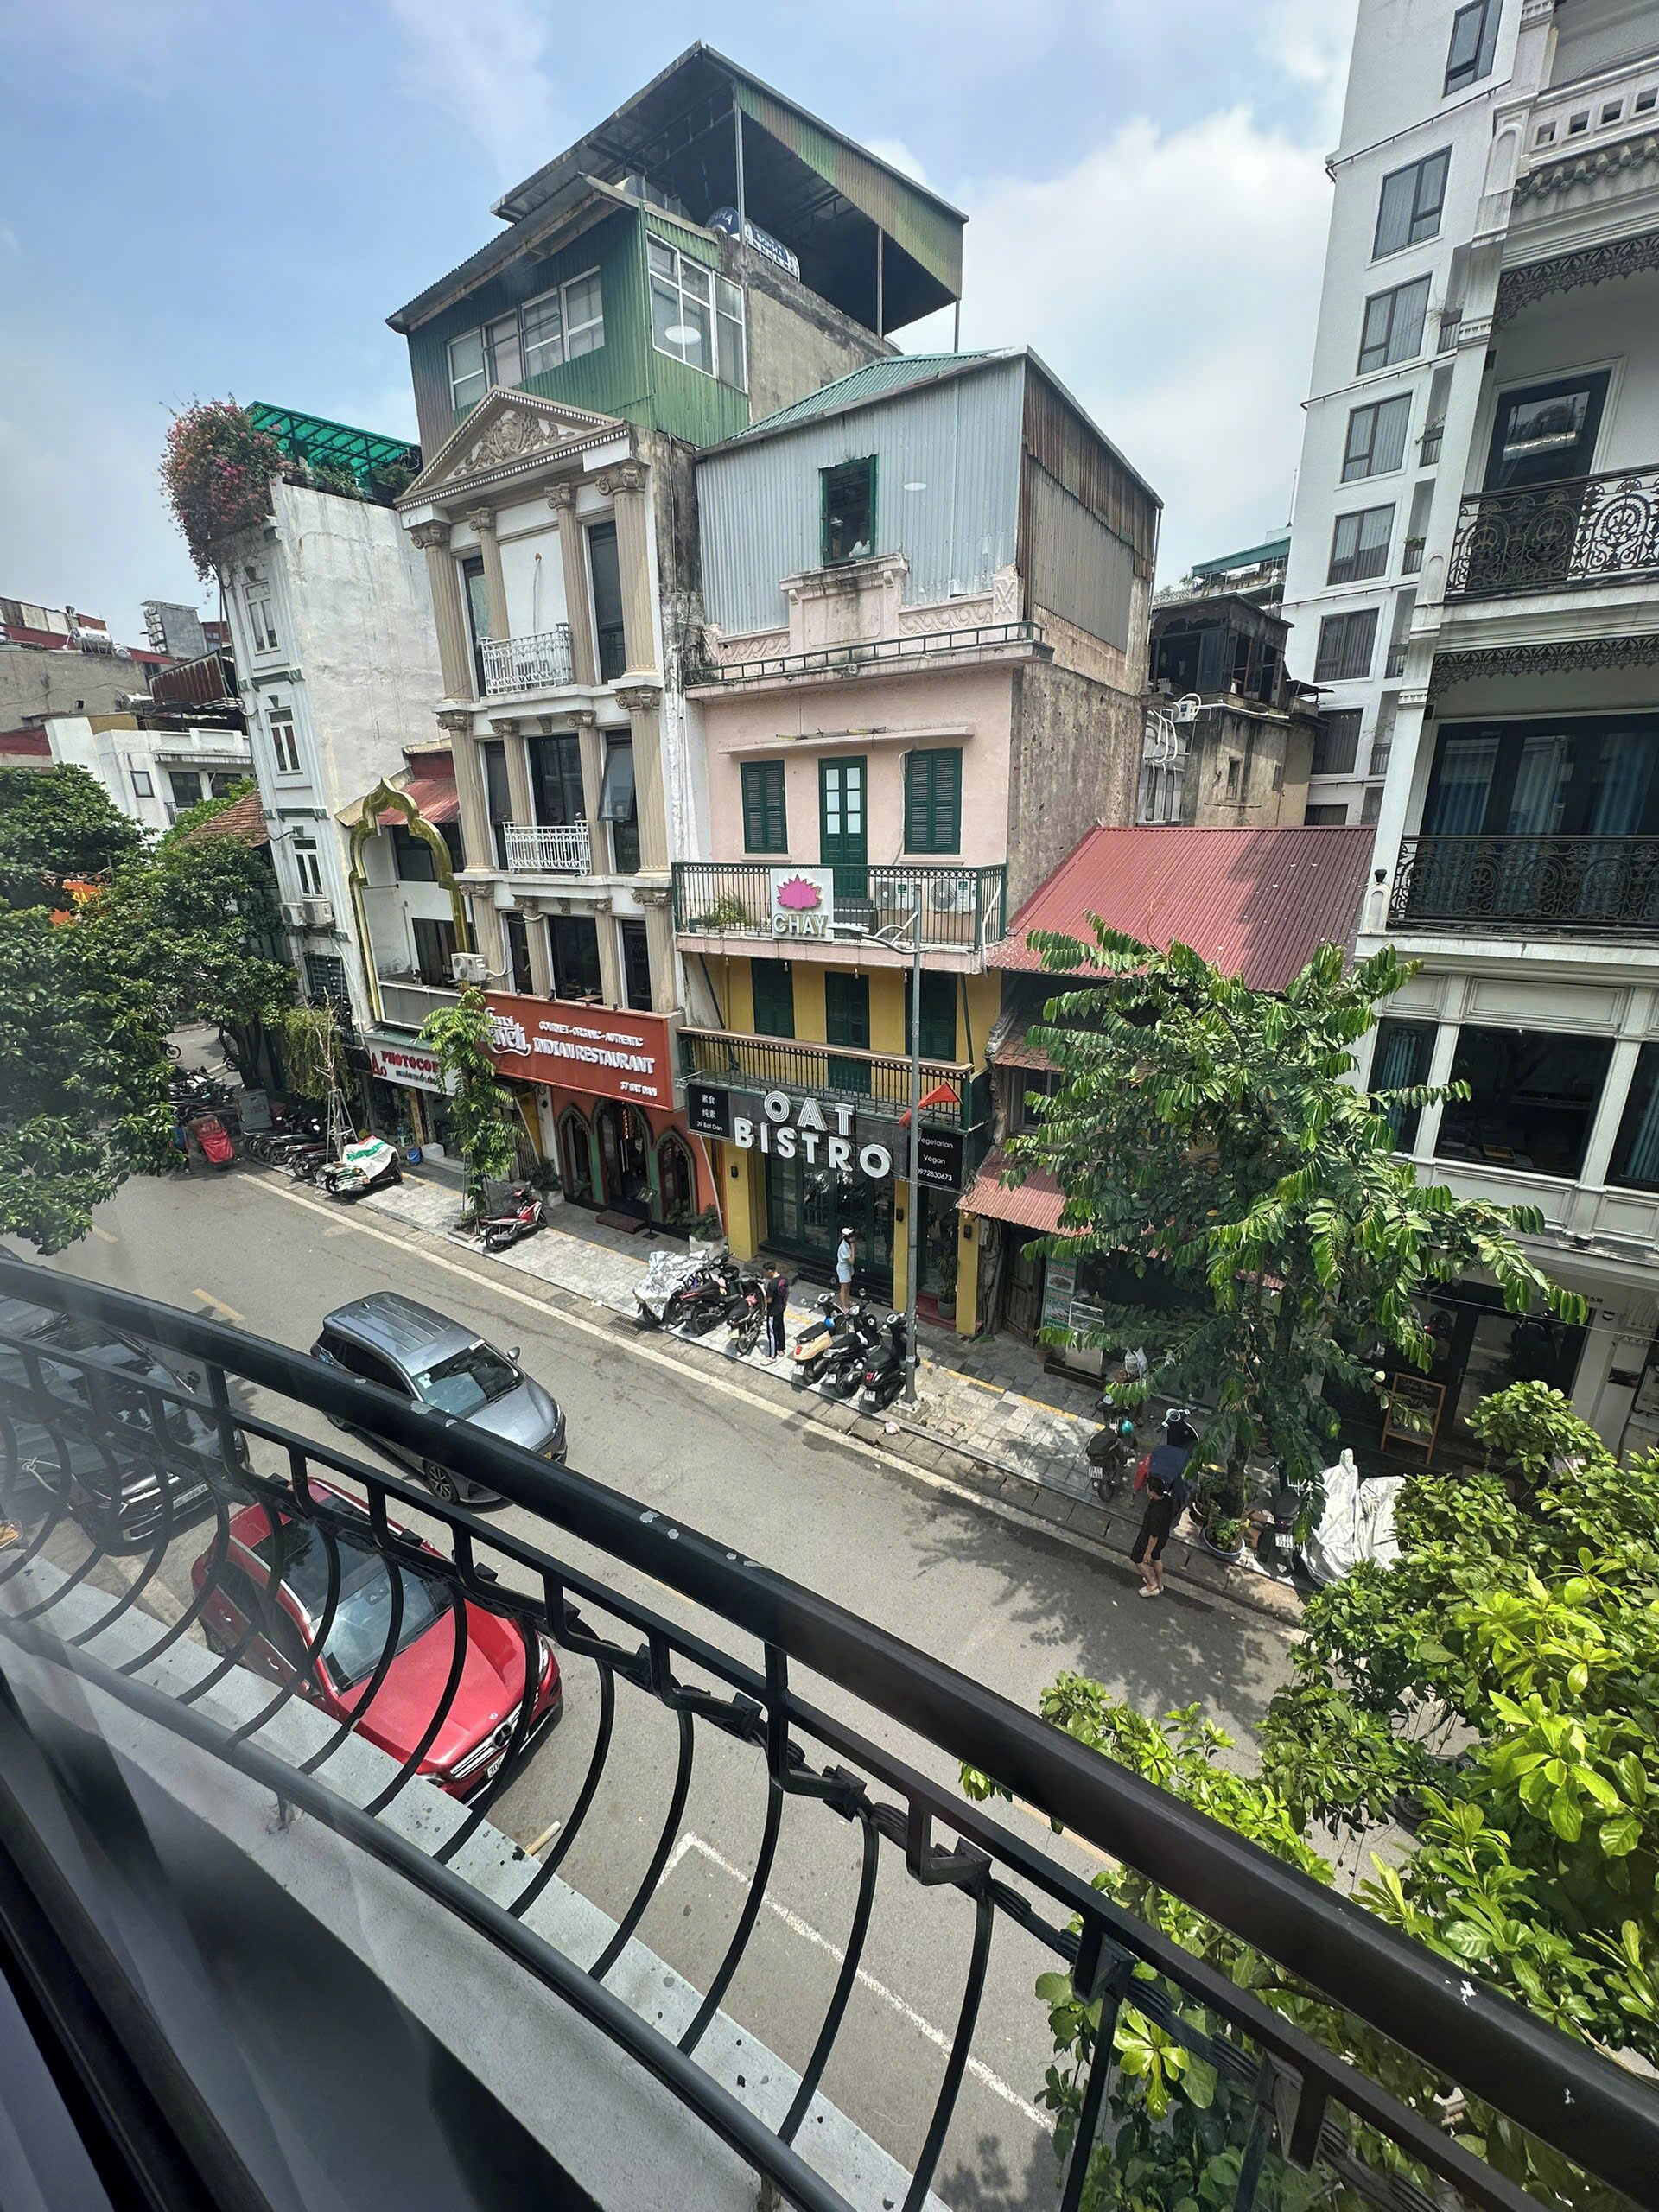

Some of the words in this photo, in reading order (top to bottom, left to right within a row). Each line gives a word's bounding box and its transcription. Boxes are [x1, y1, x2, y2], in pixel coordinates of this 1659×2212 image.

[772, 913, 829, 936] CHAY
[380, 1050, 439, 1073] PHOTOCOP
[532, 1037, 575, 1060] INDIAN
[575, 1045, 656, 1075] RESTAURANT
[764, 1090, 856, 1137] OAT
[734, 1116, 893, 1179] BISTRO
[923, 1154, 946, 1165] Vegan
